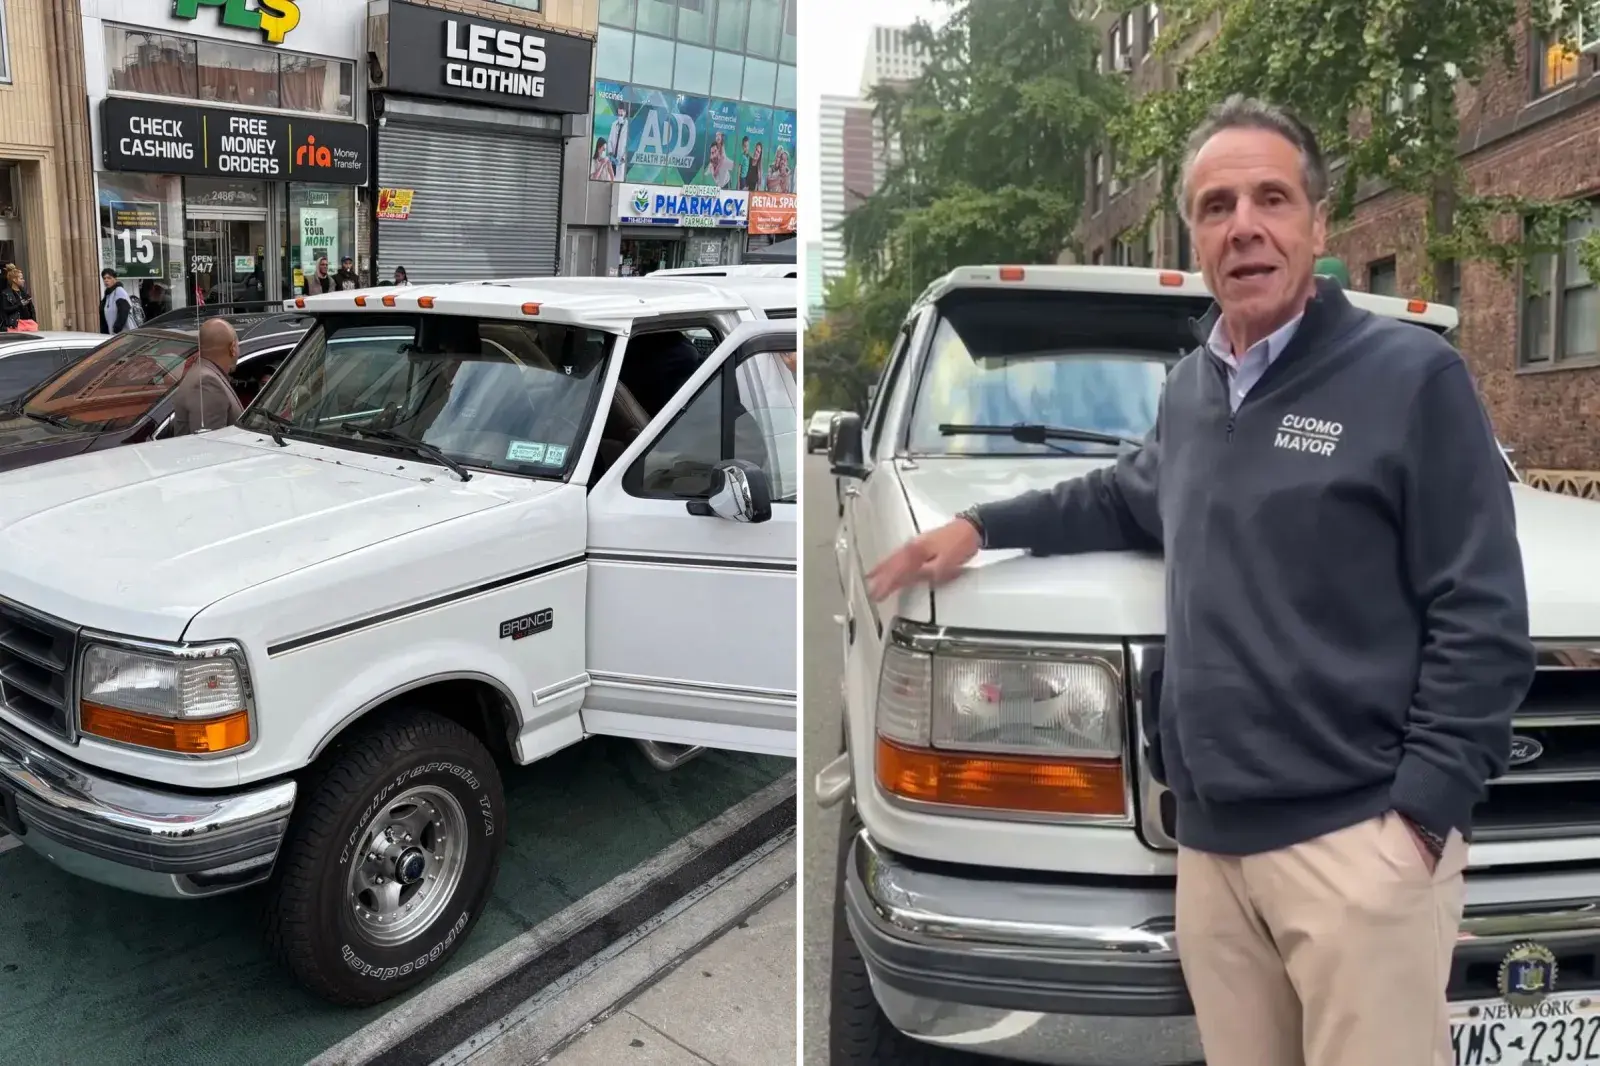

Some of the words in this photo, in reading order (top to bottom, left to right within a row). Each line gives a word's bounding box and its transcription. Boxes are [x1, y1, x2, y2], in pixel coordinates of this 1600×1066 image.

[446, 19, 547, 72] LESS
[446, 63, 545, 97] CLOTHING
[129, 116, 183, 138] CHECK
[229, 116, 268, 136] FREE
[636, 109, 697, 159] ADD
[778, 123, 793, 134] OTC
[120, 137, 194, 160] CASHING
[221, 136, 276, 155] MONEY
[296, 135, 331, 167] ria
[334, 147, 358, 161] Money
[218, 154, 280, 174] ORDERS
[334, 158, 362, 170] Transfer
[636, 153, 659, 164] HEALTH
[660, 155, 693, 168] PHARMACY
[655, 194, 744, 216] PHARMACY
[751, 196, 777, 208] RETAIL
[304, 218, 317, 226] GET
[305, 227, 324, 235] YOUR
[683, 216, 714, 226] FARMACIA
[305, 236, 335, 246] MONEY
[191, 263, 213, 273] 24/7
[1282, 414, 1343, 435] CUOMO
[1274, 432, 1336, 457] MAYOR
[502, 611, 552, 636] BRONCO
[340, 762, 480, 864] Trail-Terrain
[480, 794, 495, 837] T/A
[342, 911, 470, 980] BFGoodrich
[1483, 1004, 1522, 1020] NEW
[1530, 1000, 1576, 1018] YORK
